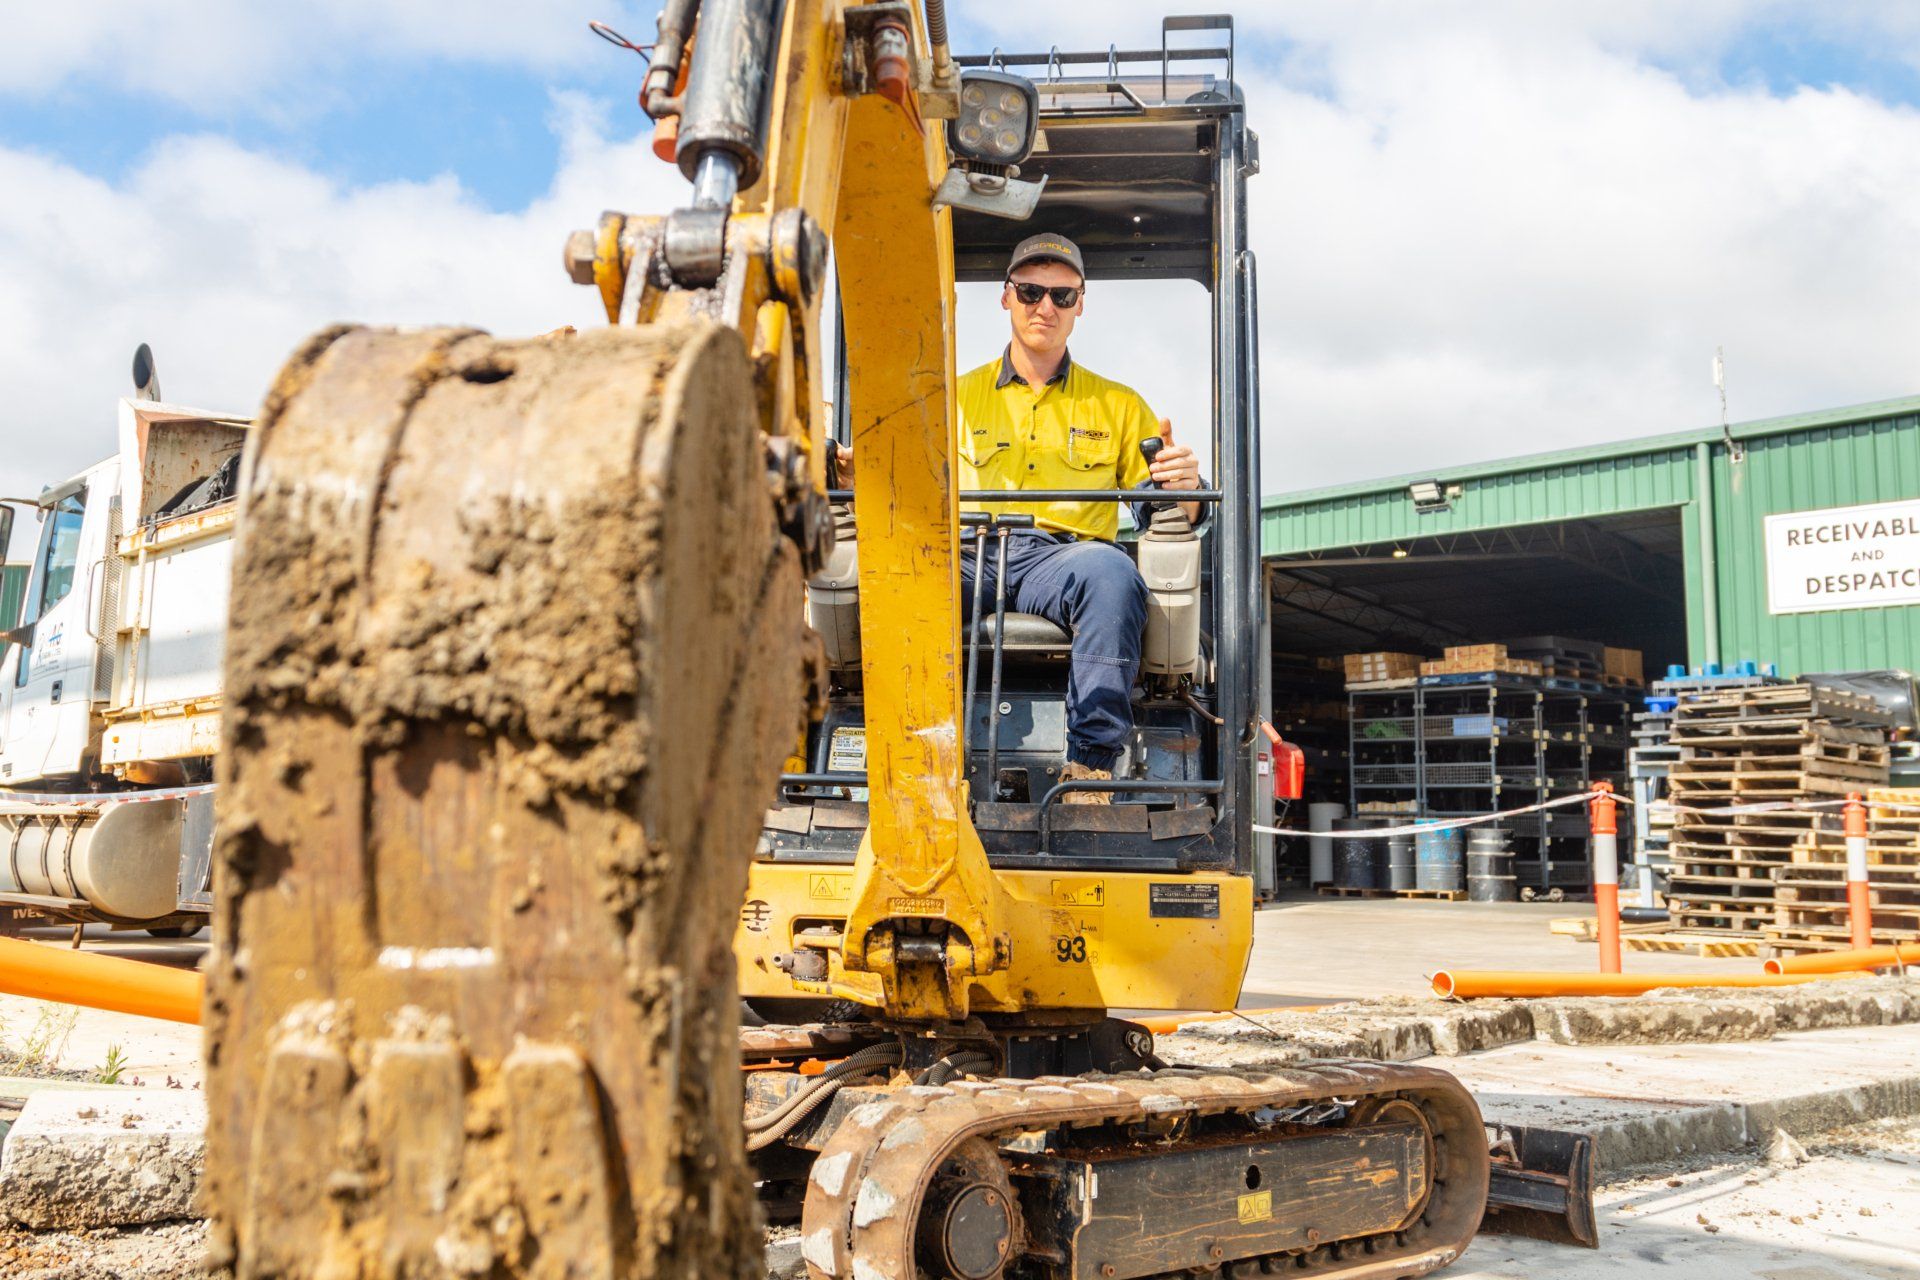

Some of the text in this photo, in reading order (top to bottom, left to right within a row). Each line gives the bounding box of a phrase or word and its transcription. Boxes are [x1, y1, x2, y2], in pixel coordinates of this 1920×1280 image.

[1851, 549, 1885, 562] AND
[1806, 568, 1920, 595] DESPATC
[1057, 935, 1086, 963] 93
